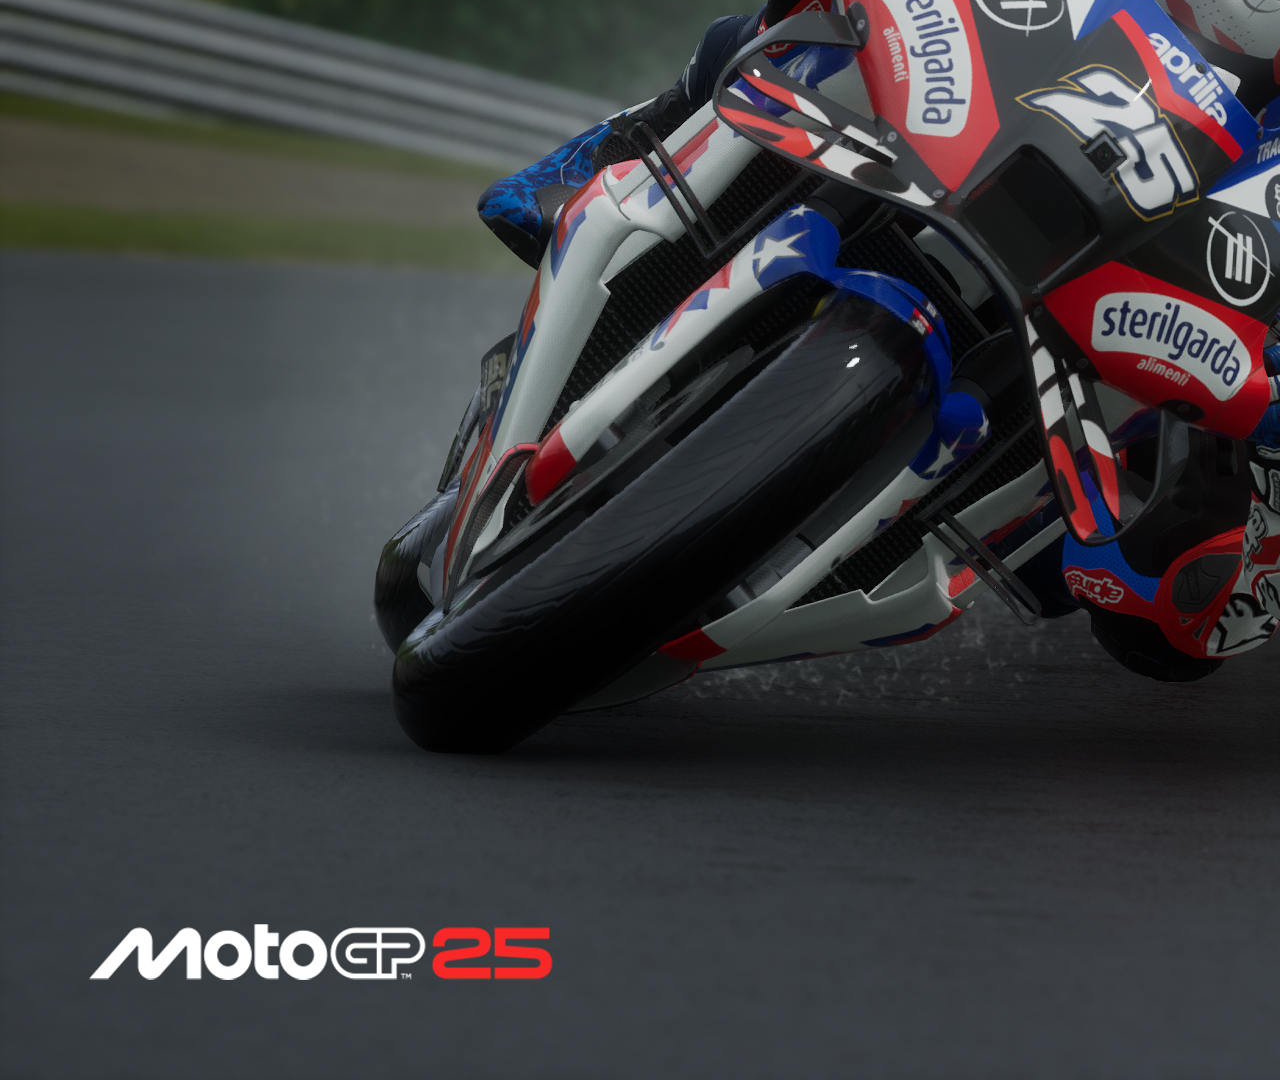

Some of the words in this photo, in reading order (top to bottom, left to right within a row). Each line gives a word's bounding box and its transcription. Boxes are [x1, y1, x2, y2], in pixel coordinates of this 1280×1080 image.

[883, 26, 910, 83] alimenti
[1149, 32, 1228, 127] aprilia
[1022, 66, 1199, 218] 25
[1101, 301, 1241, 387] sterilgarda
[1136, 355, 1192, 387] alimenti
